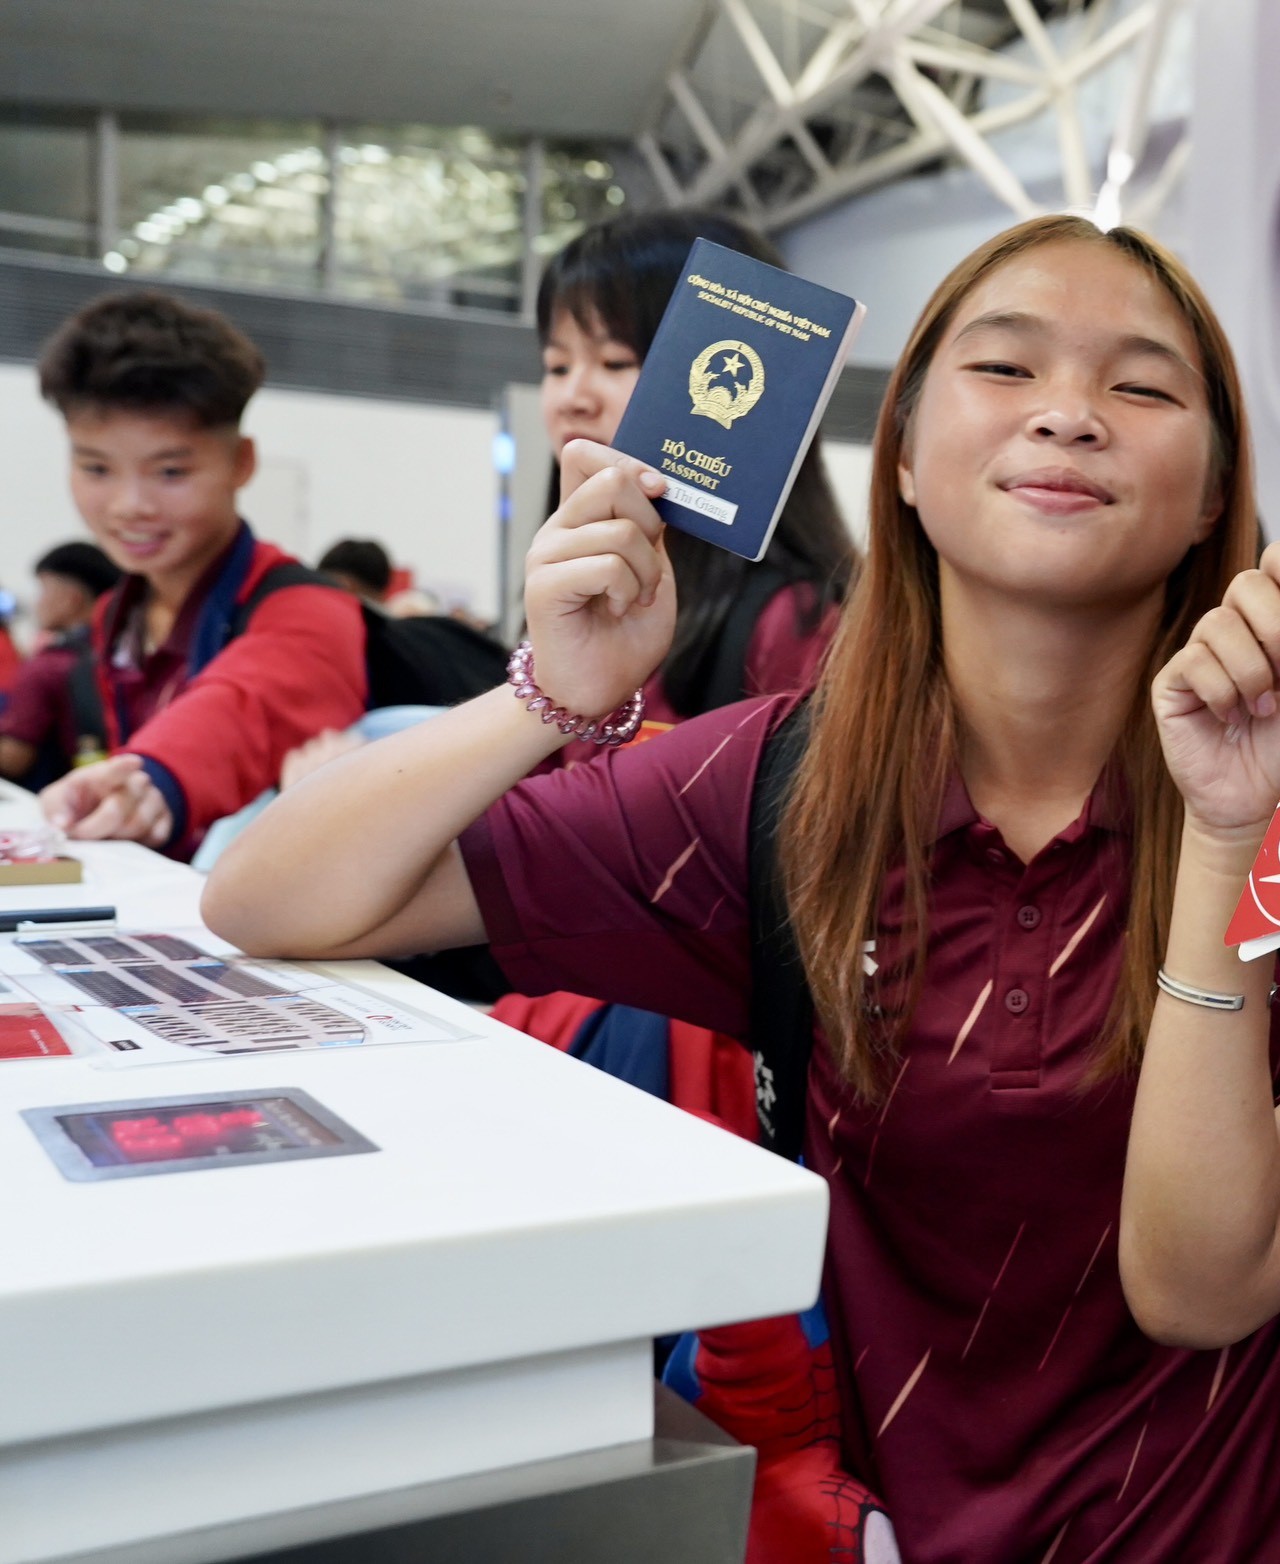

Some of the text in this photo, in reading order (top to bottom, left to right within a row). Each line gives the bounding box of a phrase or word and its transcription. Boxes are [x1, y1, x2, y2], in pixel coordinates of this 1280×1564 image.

[764, 318, 777, 327] OF
[791, 328, 810, 341] NAM
[810, 323, 831, 338] NAM
[661, 439, 733, 477] HỘ CHIẾU
[661, 458, 720, 490] PASSPORT
[695, 496, 728, 521] Giang
